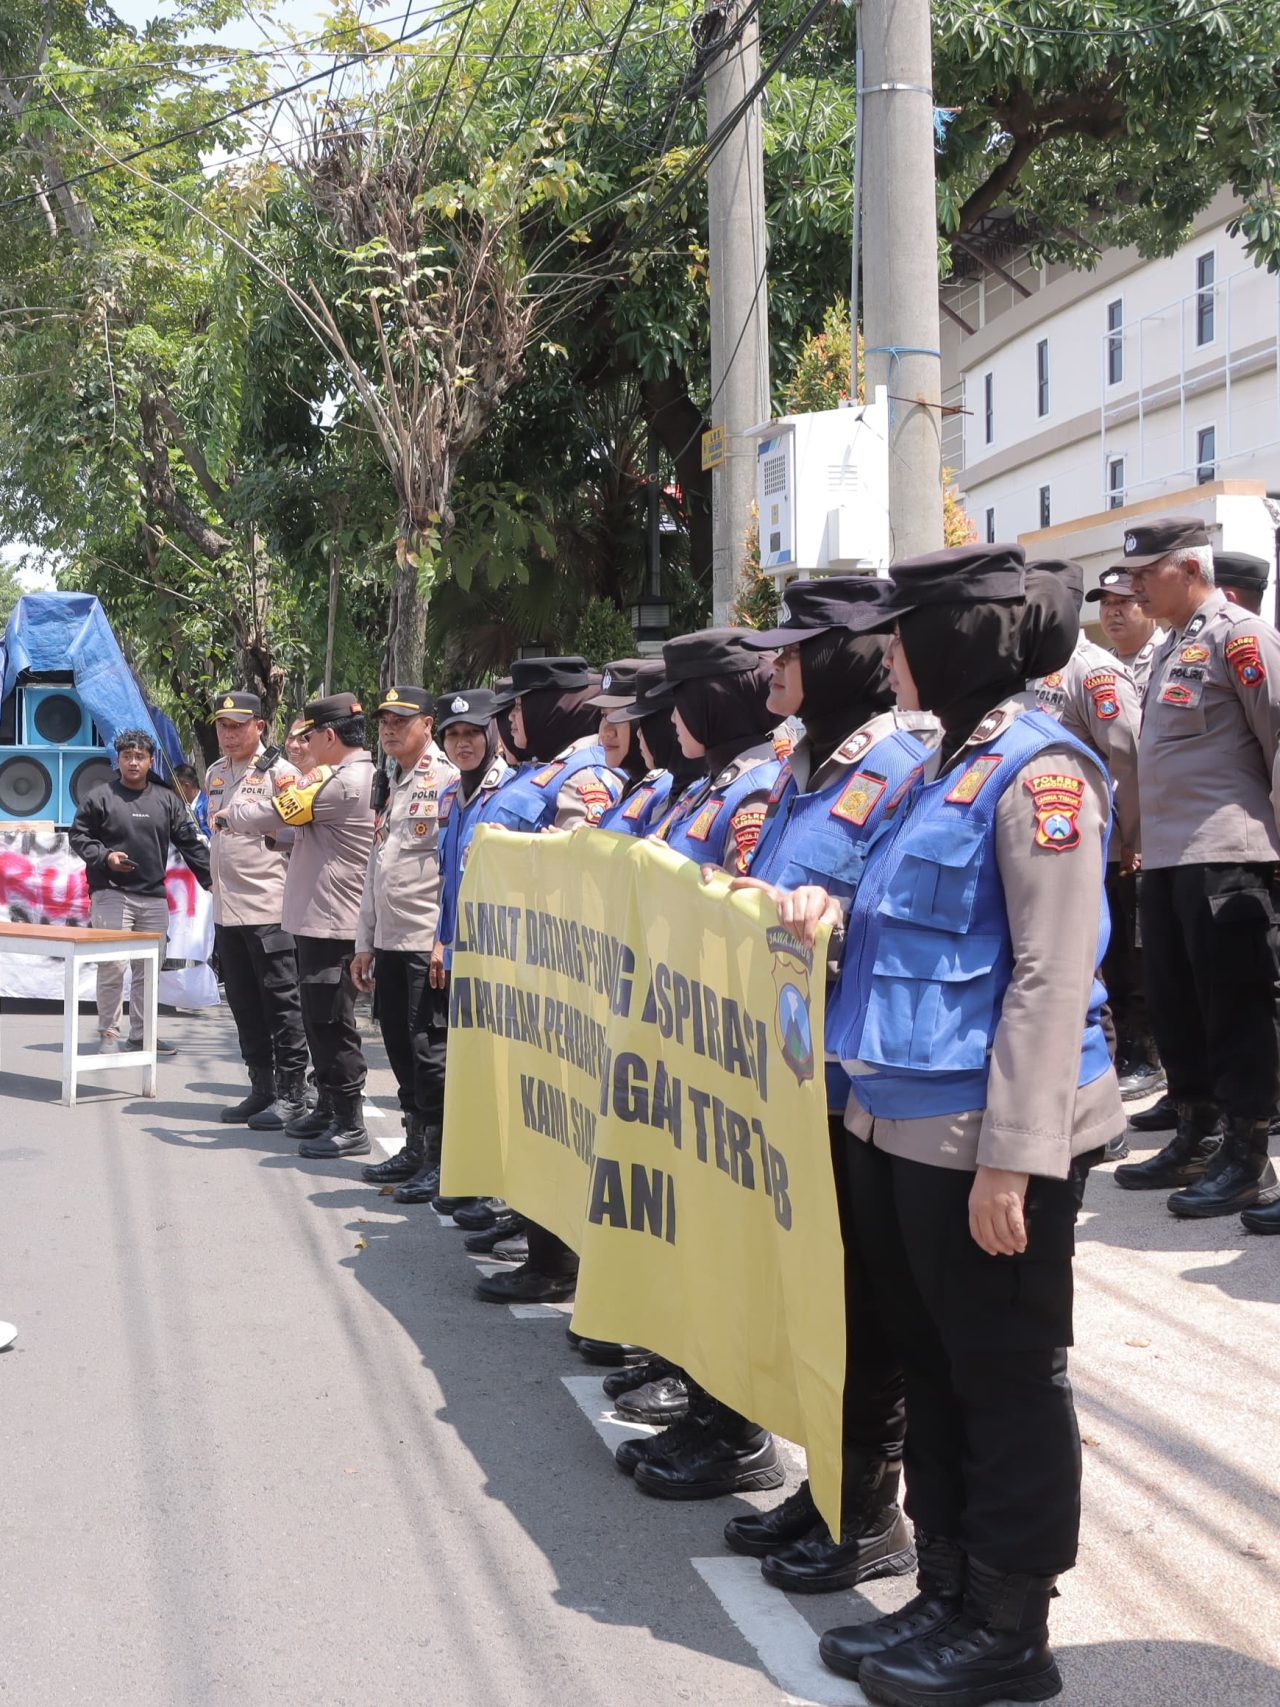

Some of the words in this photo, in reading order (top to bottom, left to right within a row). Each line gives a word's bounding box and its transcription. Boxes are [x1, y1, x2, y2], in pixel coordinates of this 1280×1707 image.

[241, 786, 266, 796] POLRI
[411, 790, 438, 800] POLRI
[526, 909, 585, 983] DATANG
[520, 1074, 570, 1149] KAMI
